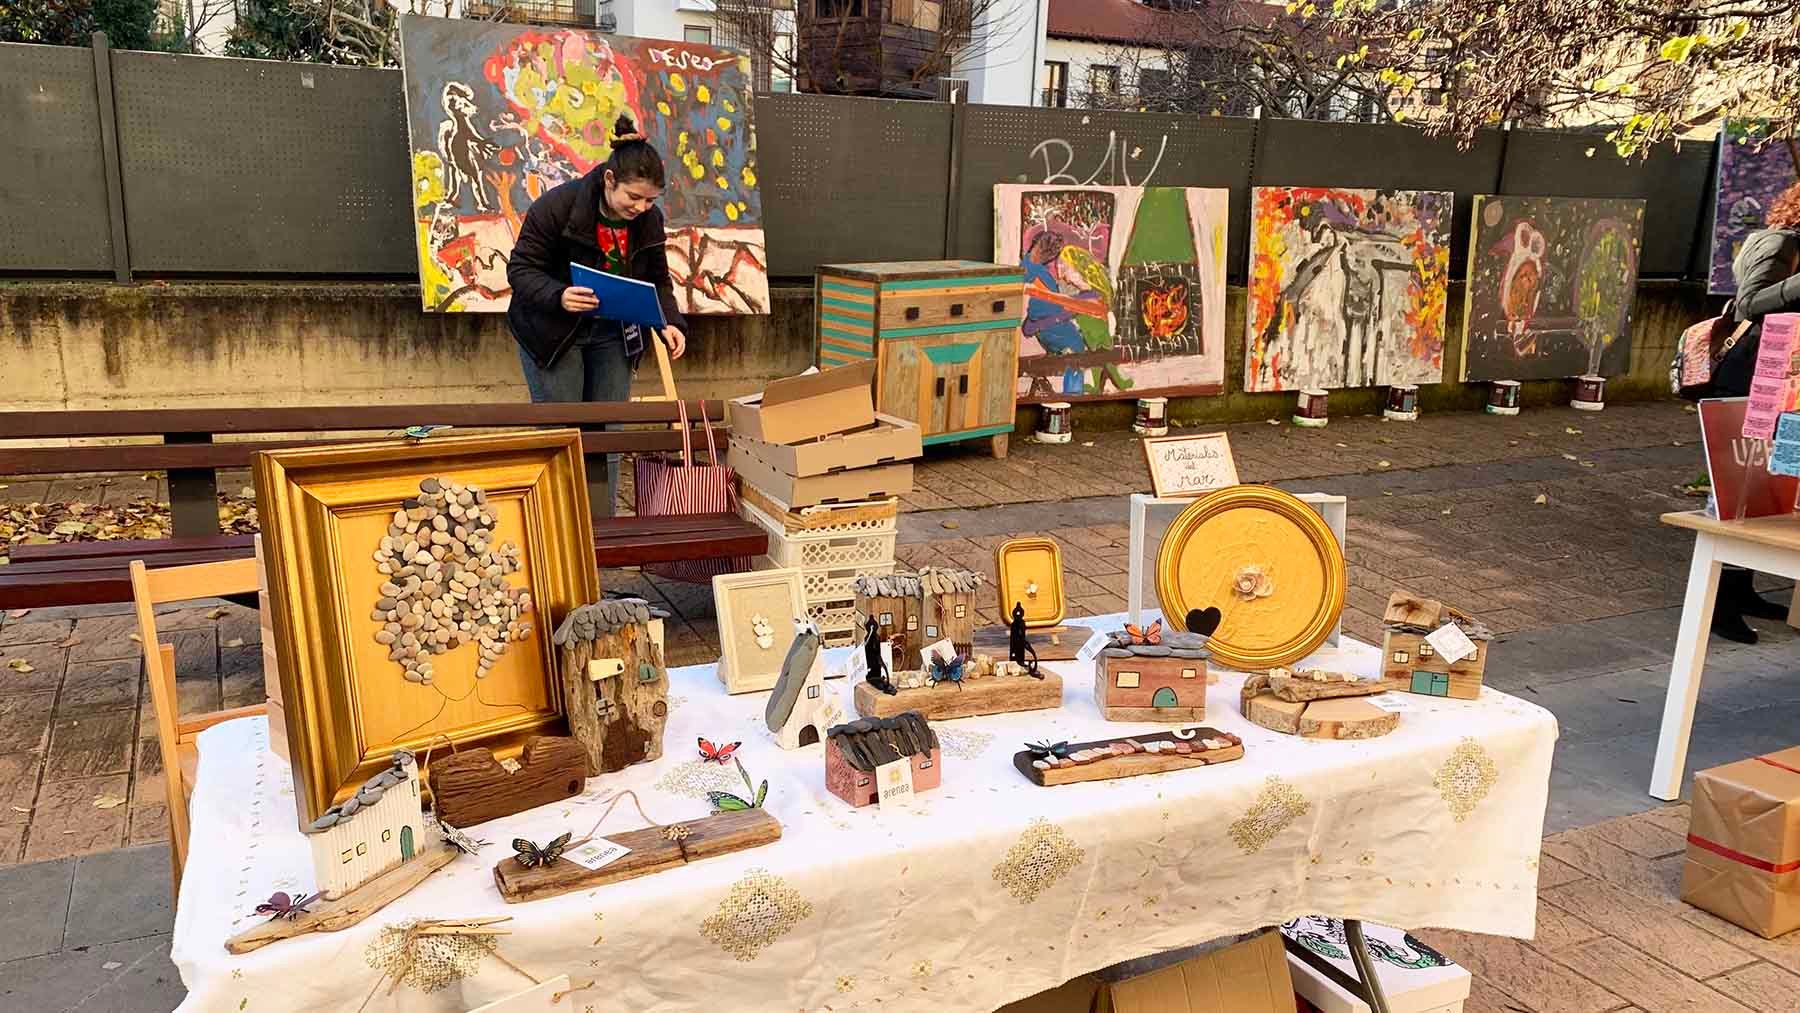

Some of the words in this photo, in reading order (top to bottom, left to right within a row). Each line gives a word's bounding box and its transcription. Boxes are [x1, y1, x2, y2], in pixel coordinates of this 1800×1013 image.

[1164, 445, 1219, 461] Materiales
[883, 783, 910, 799] arenea
[585, 847, 618, 864] arenea
